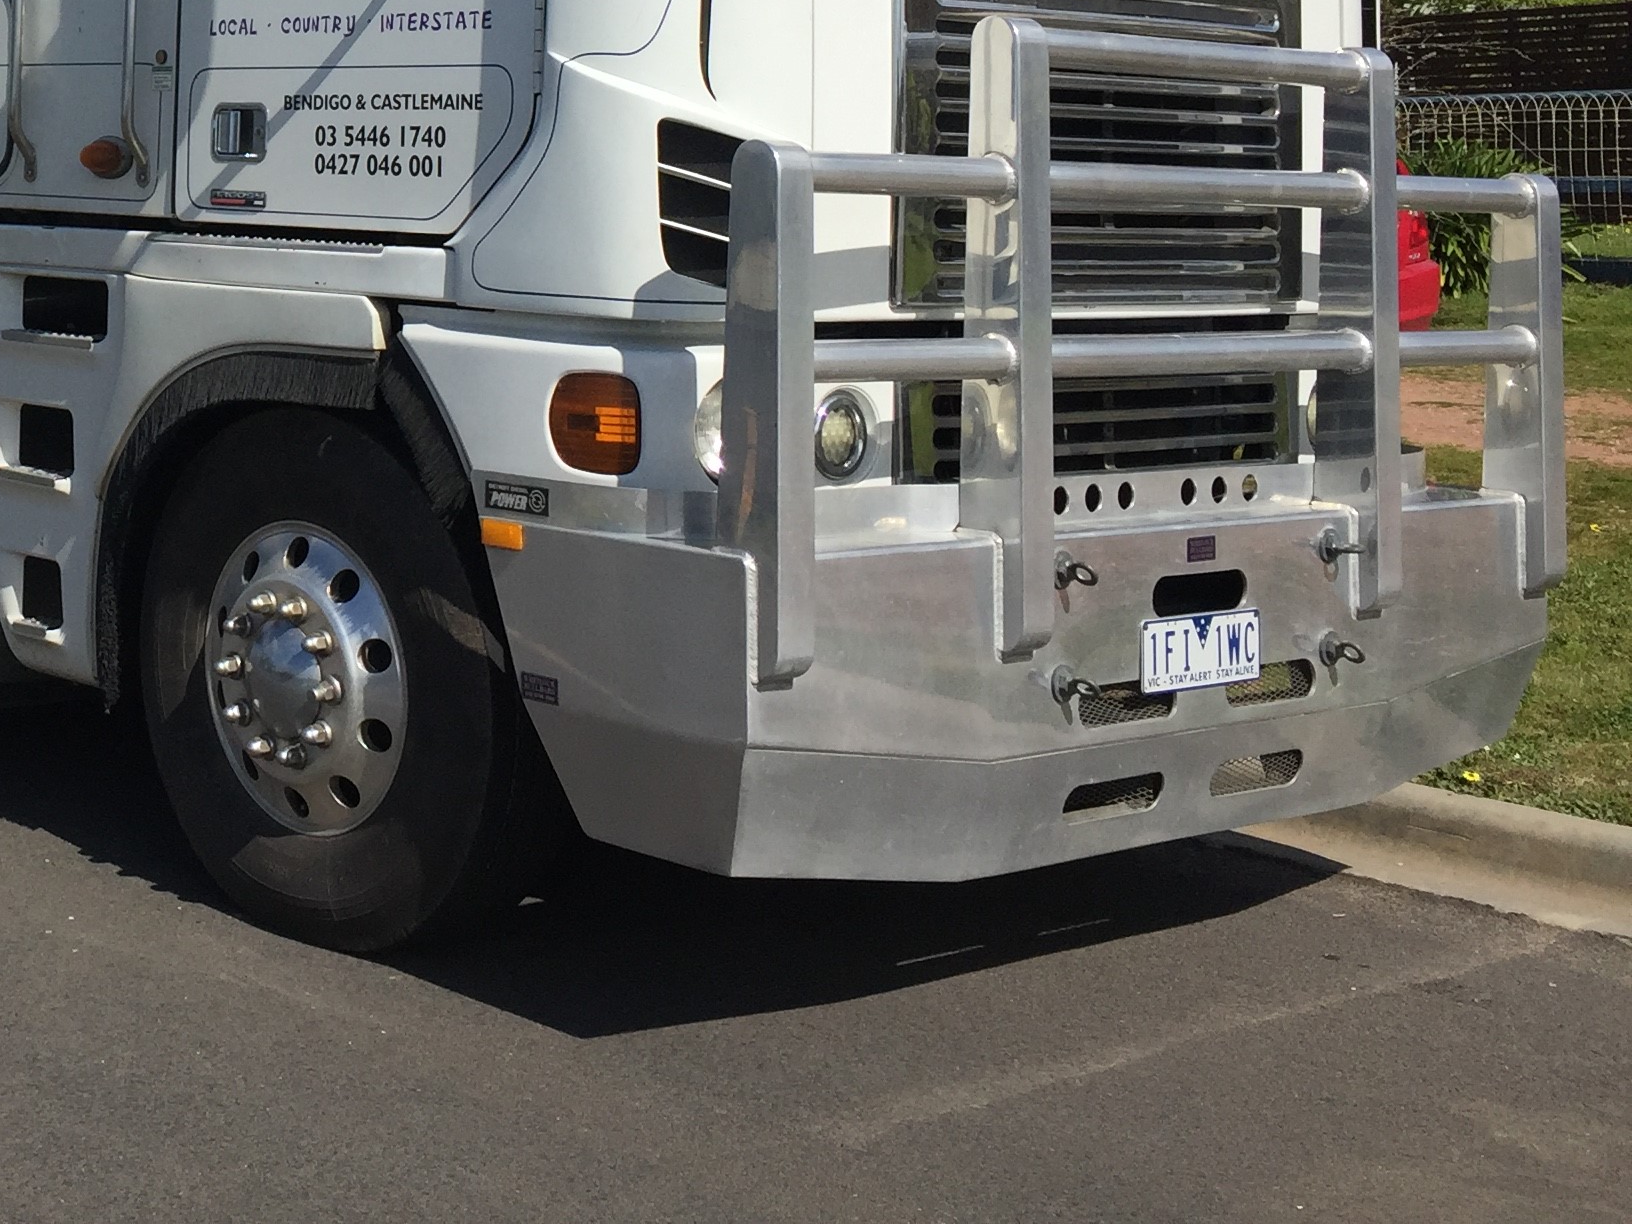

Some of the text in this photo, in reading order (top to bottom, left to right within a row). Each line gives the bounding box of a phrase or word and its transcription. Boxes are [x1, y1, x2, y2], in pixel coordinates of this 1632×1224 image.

[209, 10, 493, 38] LOCAL COUNTRY INTERSTATE
[284, 93, 484, 111] BENDIGO & CASTLEMAINE
[315, 125, 446, 148] 03 5446 1740
[314, 153, 443, 178] 0427 046 001
[490, 491, 528, 511] POWER
[1147, 677, 1161, 688] VIC
[1169, 673, 1188, 686] STAY
[1189, 670, 1212, 682] ALERT
[1216, 667, 1233, 679] STAY
[1235, 665, 1255, 676] ALIVE
